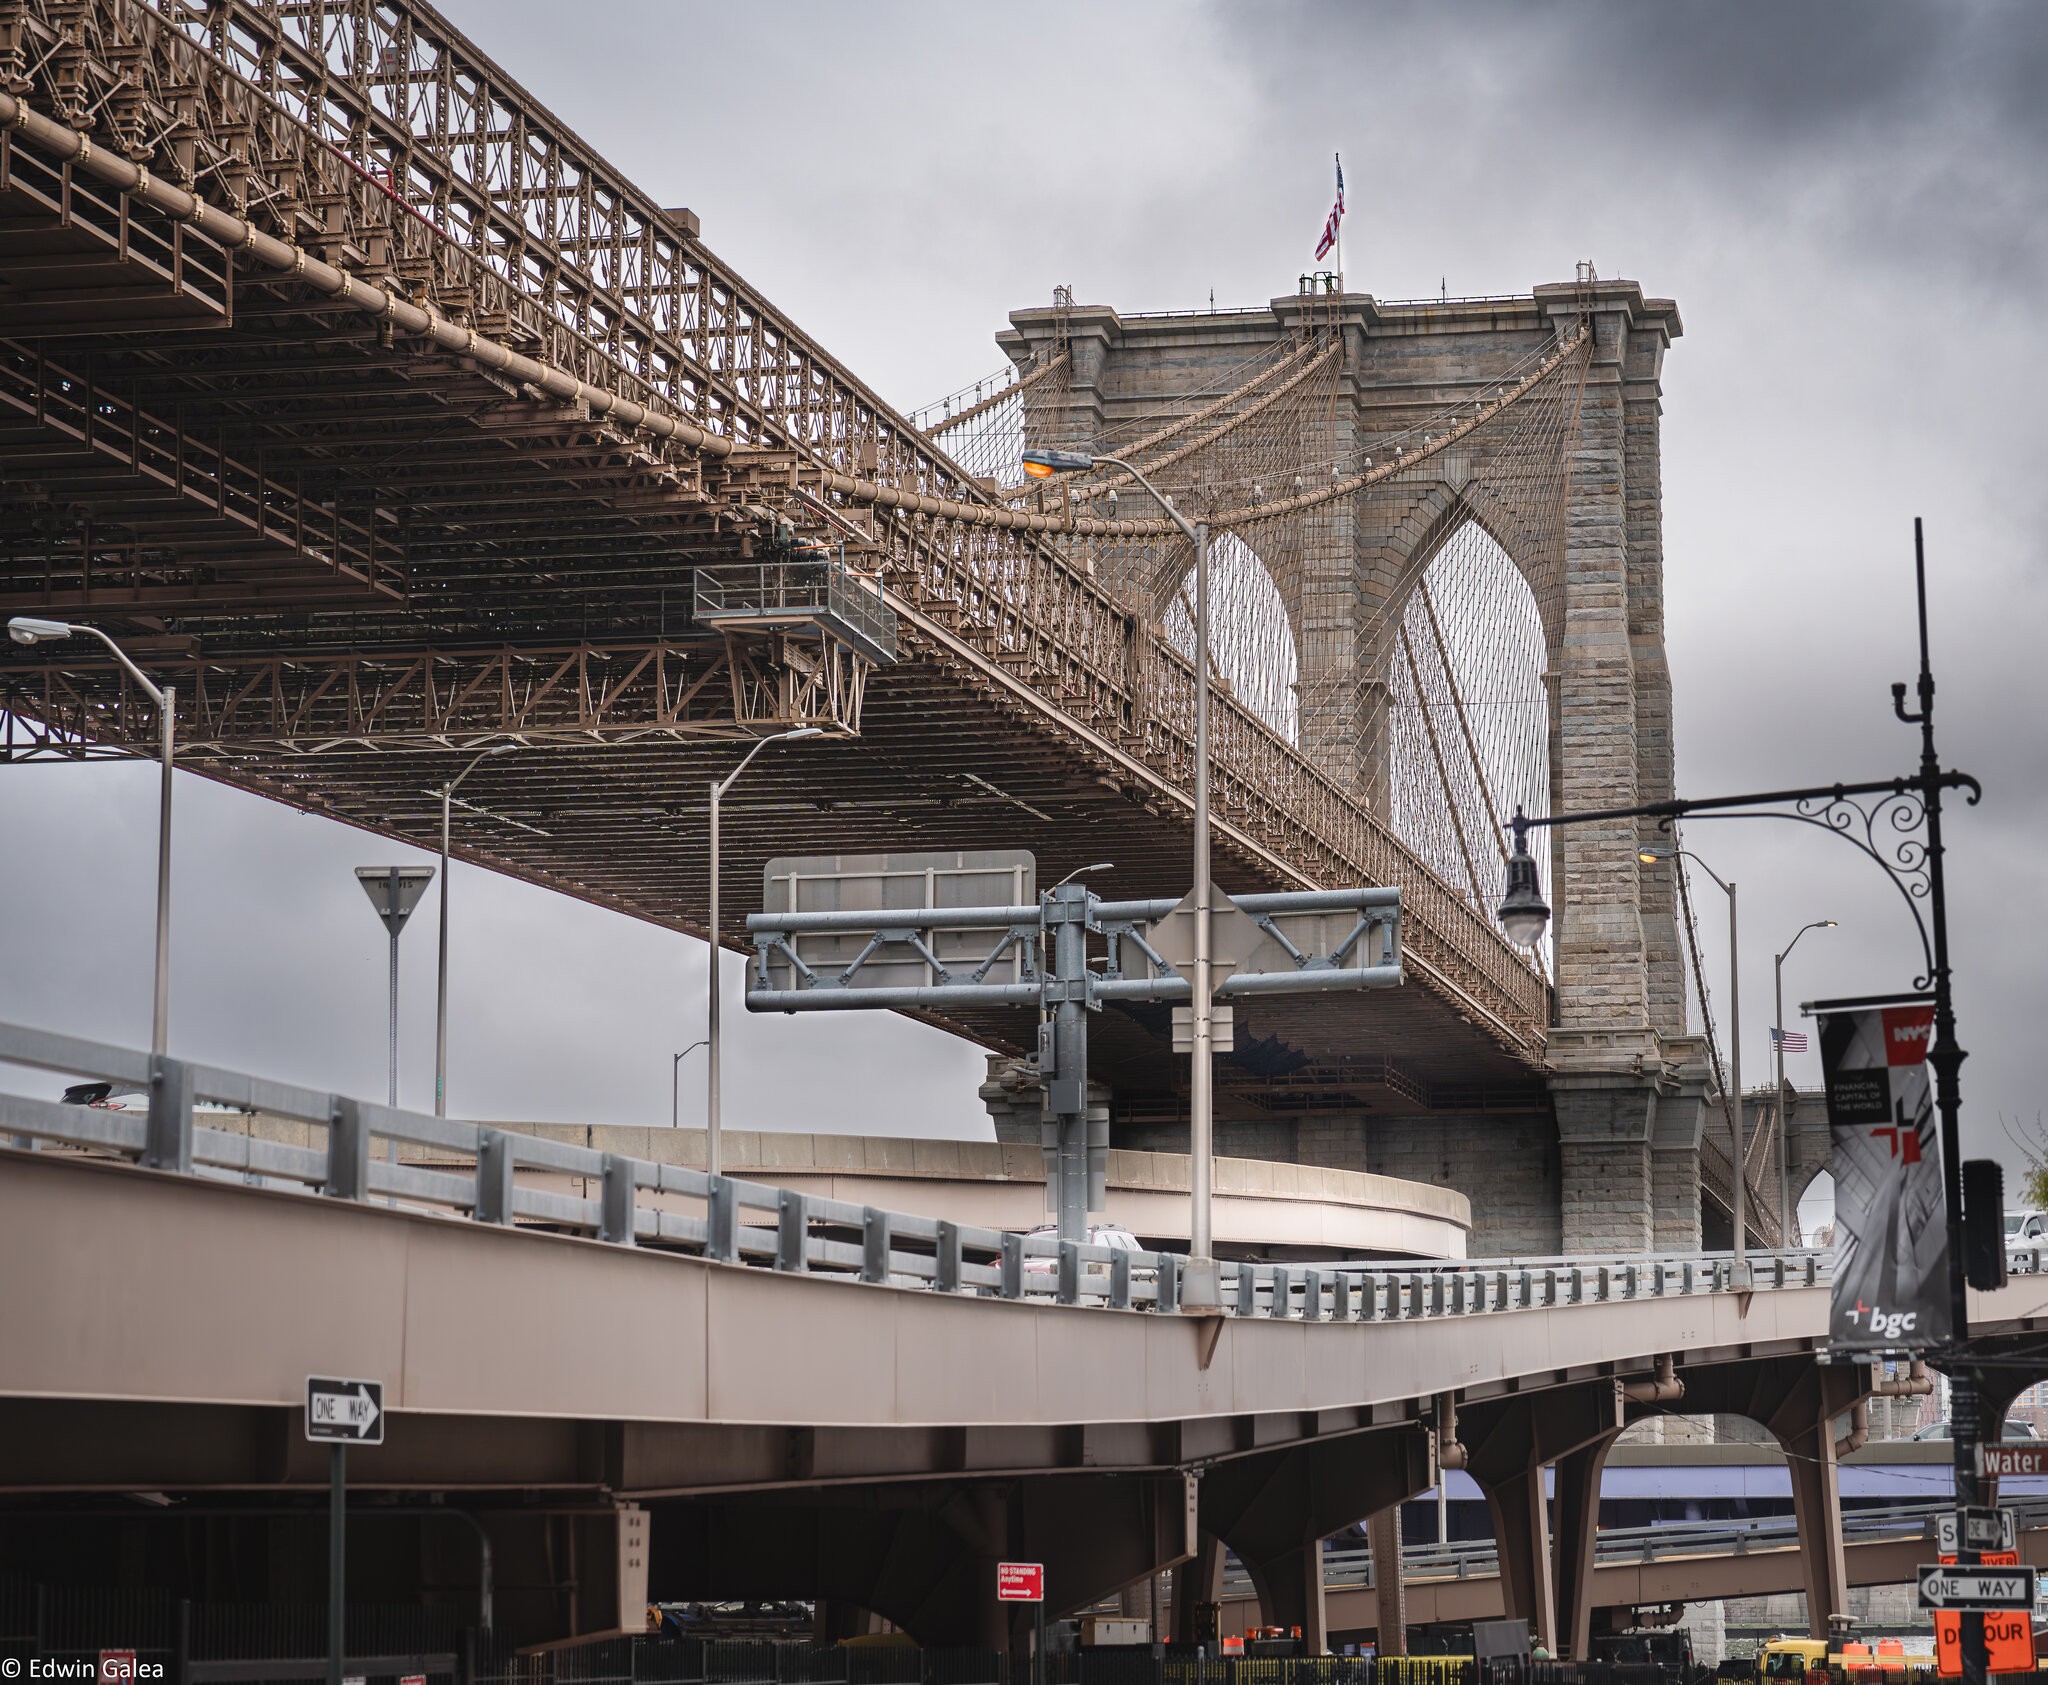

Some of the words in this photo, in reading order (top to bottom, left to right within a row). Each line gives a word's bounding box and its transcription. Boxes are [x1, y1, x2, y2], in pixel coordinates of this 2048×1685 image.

[1893, 1025, 1931, 1042] NYC
[1834, 1082, 1880, 1092] FINANCIAL
[1834, 1093, 1868, 1102] CAPITAL
[1870, 1091, 1881, 1100] OF
[1836, 1103, 1851, 1112] THE
[1853, 1101, 1883, 1111] WORLD
[1869, 1306, 1917, 1338] bgc
[316, 1397, 336, 1420] ONE
[349, 1399, 372, 1422] WAY
[1985, 1450, 2042, 1473] Water
[1001, 1567, 1009, 1575] NO
[1010, 1567, 1036, 1576] STANDING
[1928, 1580, 1960, 1596] ONE
[1978, 1581, 2016, 1597] WAY
[1944, 1623, 2023, 1645] DOUR
